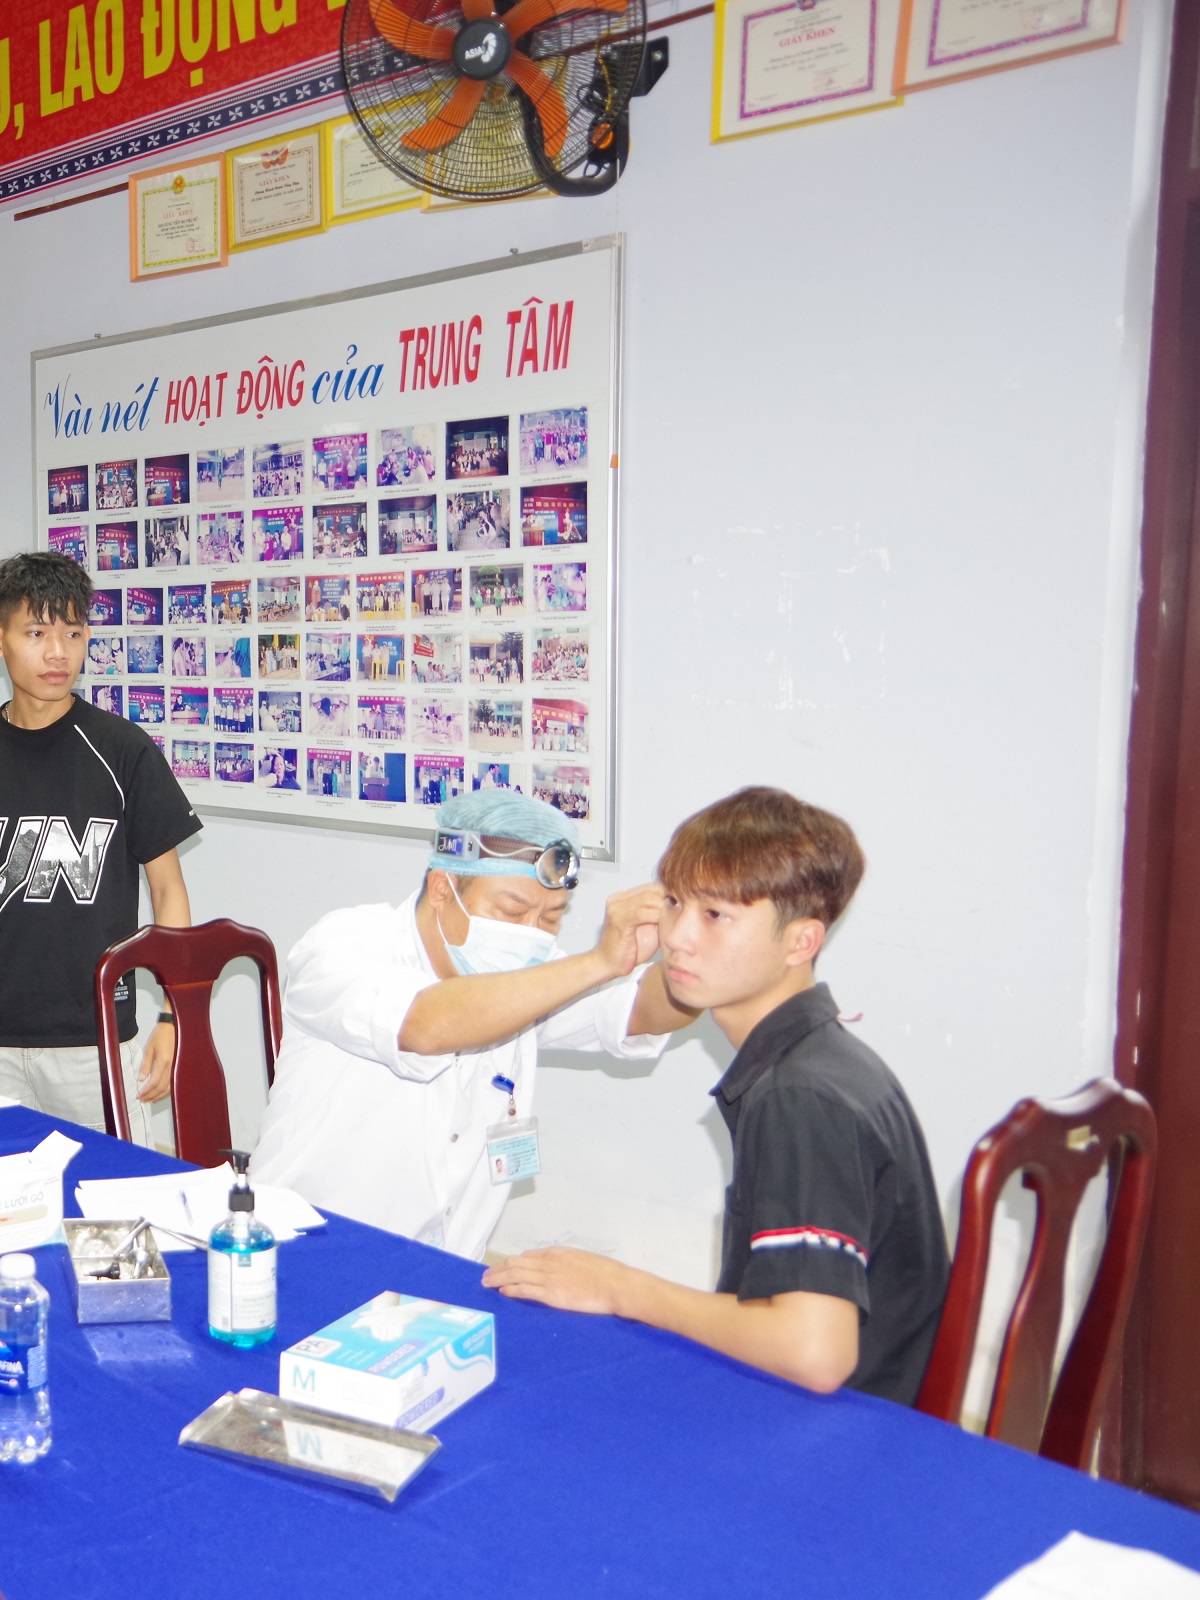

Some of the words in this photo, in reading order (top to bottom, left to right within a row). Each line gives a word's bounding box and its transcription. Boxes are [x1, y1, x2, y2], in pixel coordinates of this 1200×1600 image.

[39, 0, 125, 117] LAO
[465, 46, 484, 60] ASIA
[44, 373, 94, 438] Vài
[100, 376, 160, 432] nét
[164, 372, 228, 427] HOẠT
[236, 355, 306, 420] ĐỘNG
[311, 343, 384, 404] của
[399, 314, 482, 393] TRUNG
[505, 296, 574, 378] TÂM
[293, 1365, 315, 1392] M
